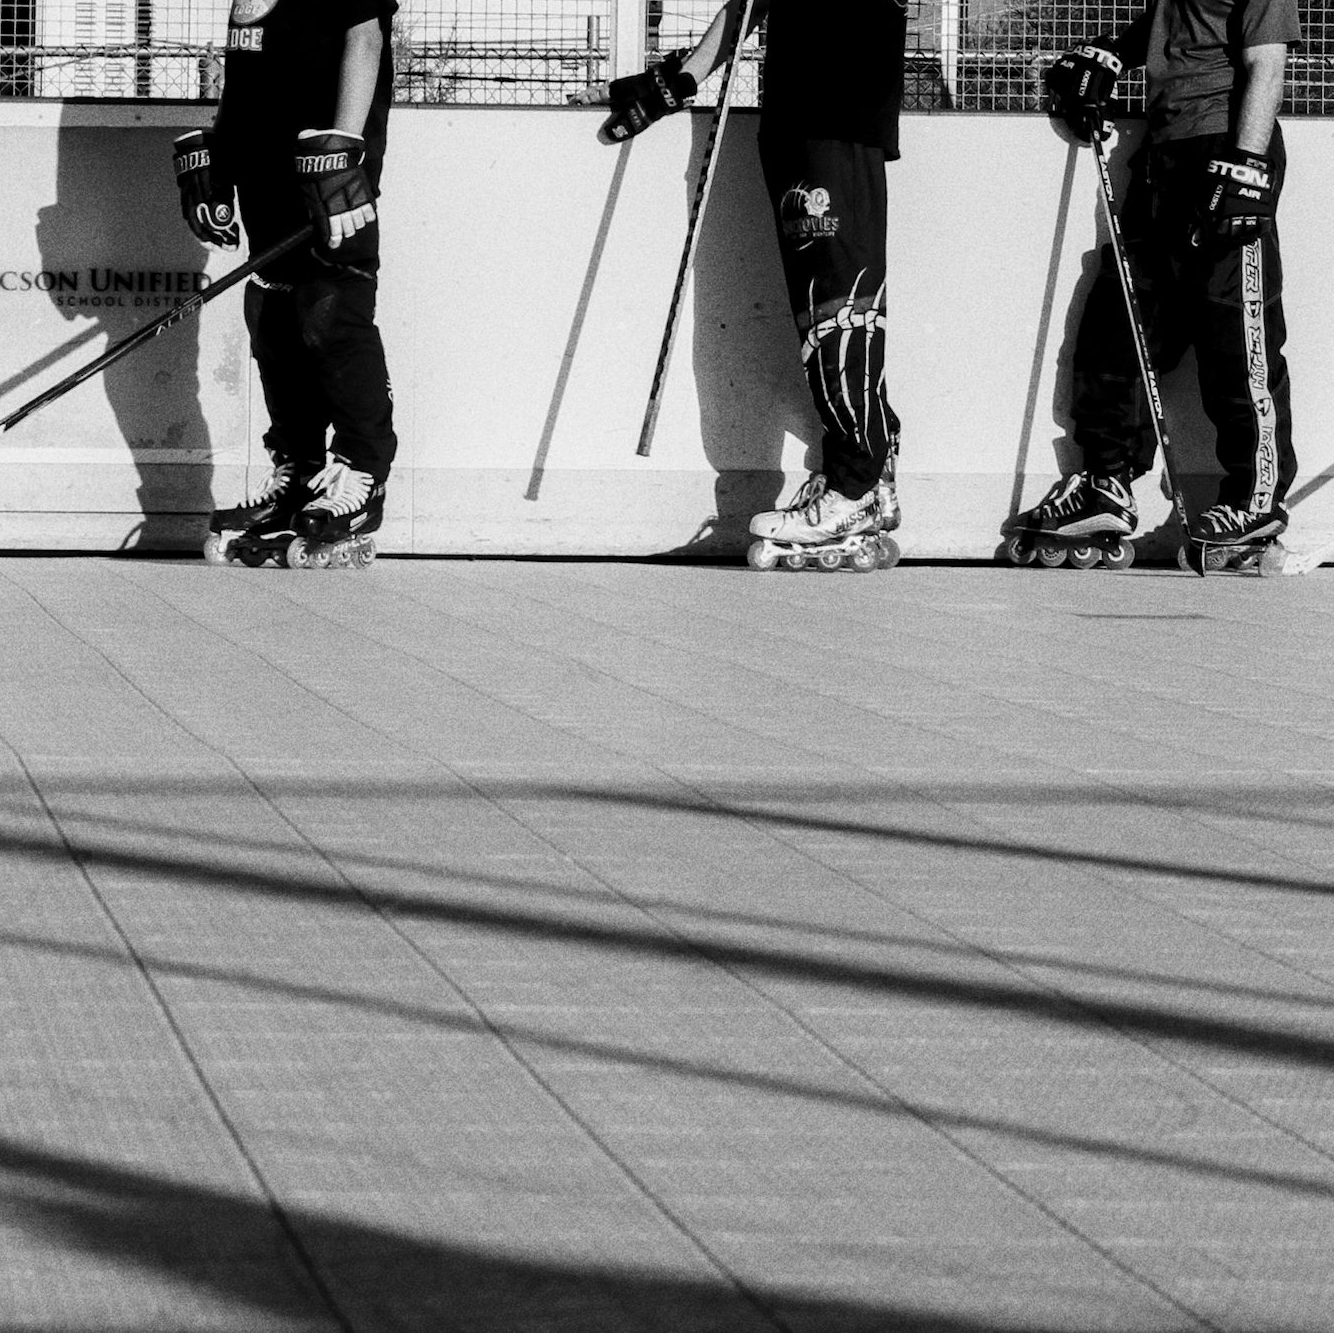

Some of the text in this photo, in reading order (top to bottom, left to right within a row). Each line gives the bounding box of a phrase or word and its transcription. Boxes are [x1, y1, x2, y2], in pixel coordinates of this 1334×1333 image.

[1065, 45, 1123, 76] ASTO
[1098, 154, 1115, 202] EASTON
[1238, 187, 1262, 200] AIR
[89, 267, 213, 293] UNIFIED
[57, 296, 184, 308] SCHOOL DISTR
[1147, 370, 1165, 420] EASTON
